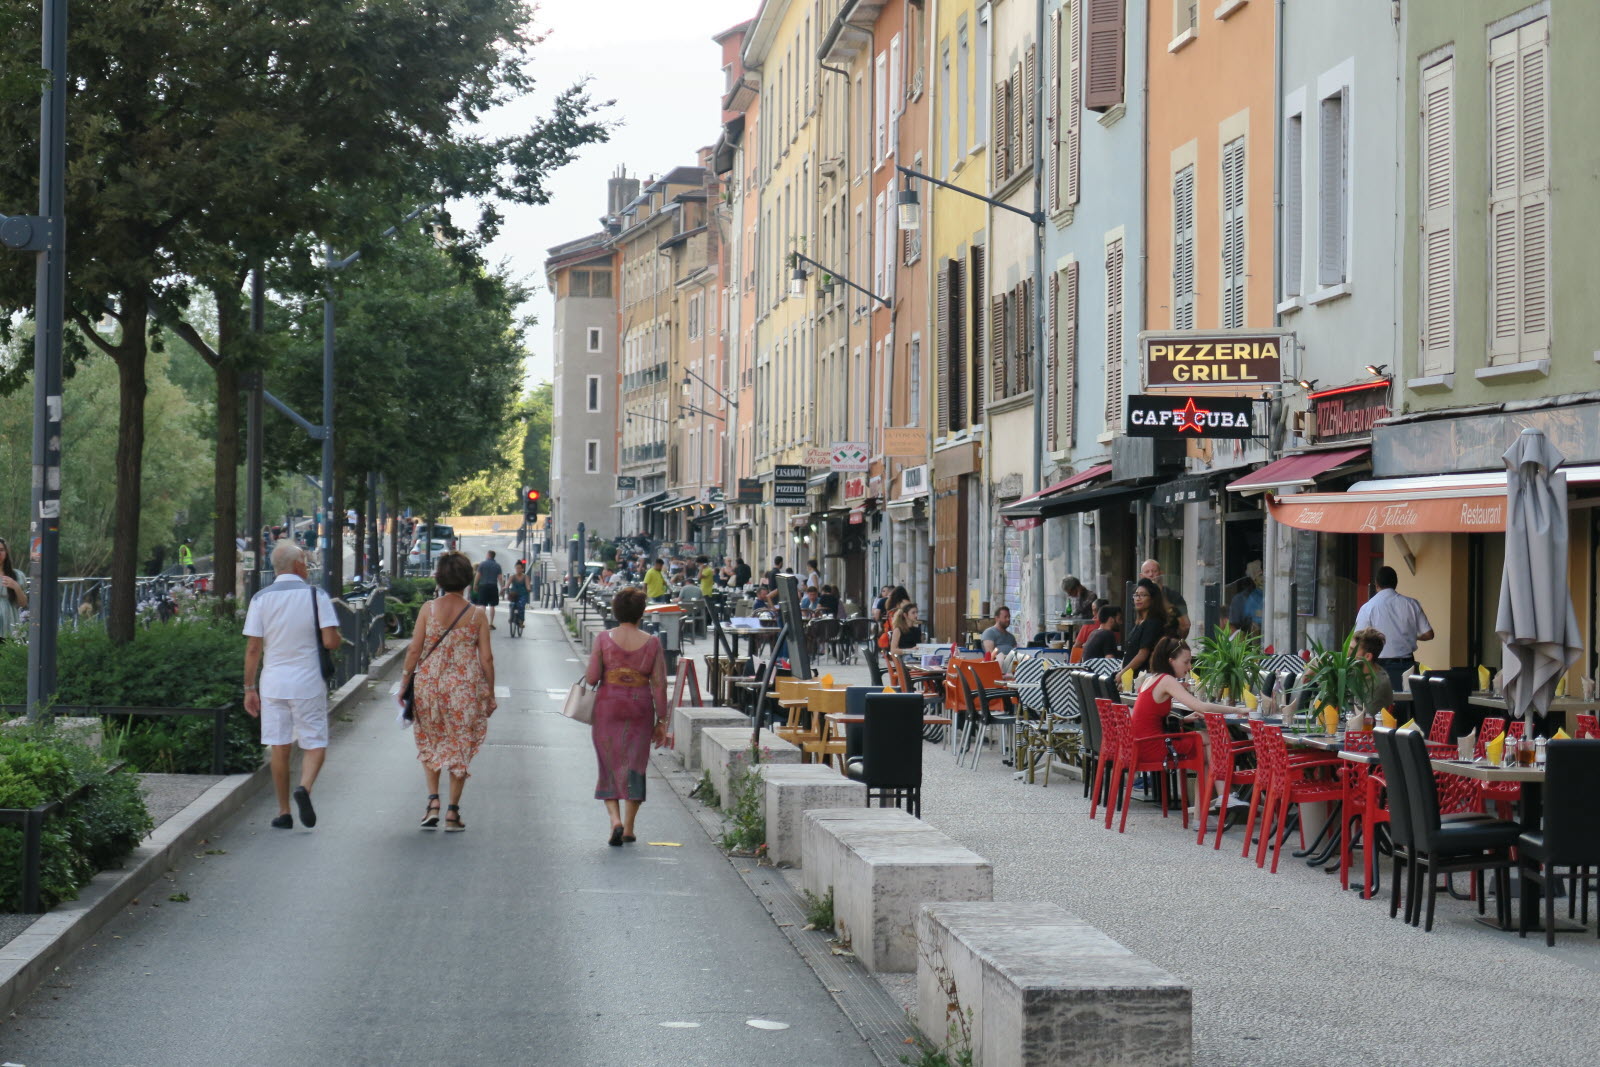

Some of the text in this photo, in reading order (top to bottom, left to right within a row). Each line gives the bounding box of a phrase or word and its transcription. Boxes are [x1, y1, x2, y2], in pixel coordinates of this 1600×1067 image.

[1149, 342, 1279, 362] PIZZERIA
[1172, 363, 1258, 382] GRILL
[1131, 410, 1249, 428] CAFE CUBA
[775, 468, 806, 478] CASANOVA
[776, 485, 805, 493] PIZZERIA
[1294, 507, 1324, 524] Pizzeria
[1460, 503, 1502, 525] Restaurant
